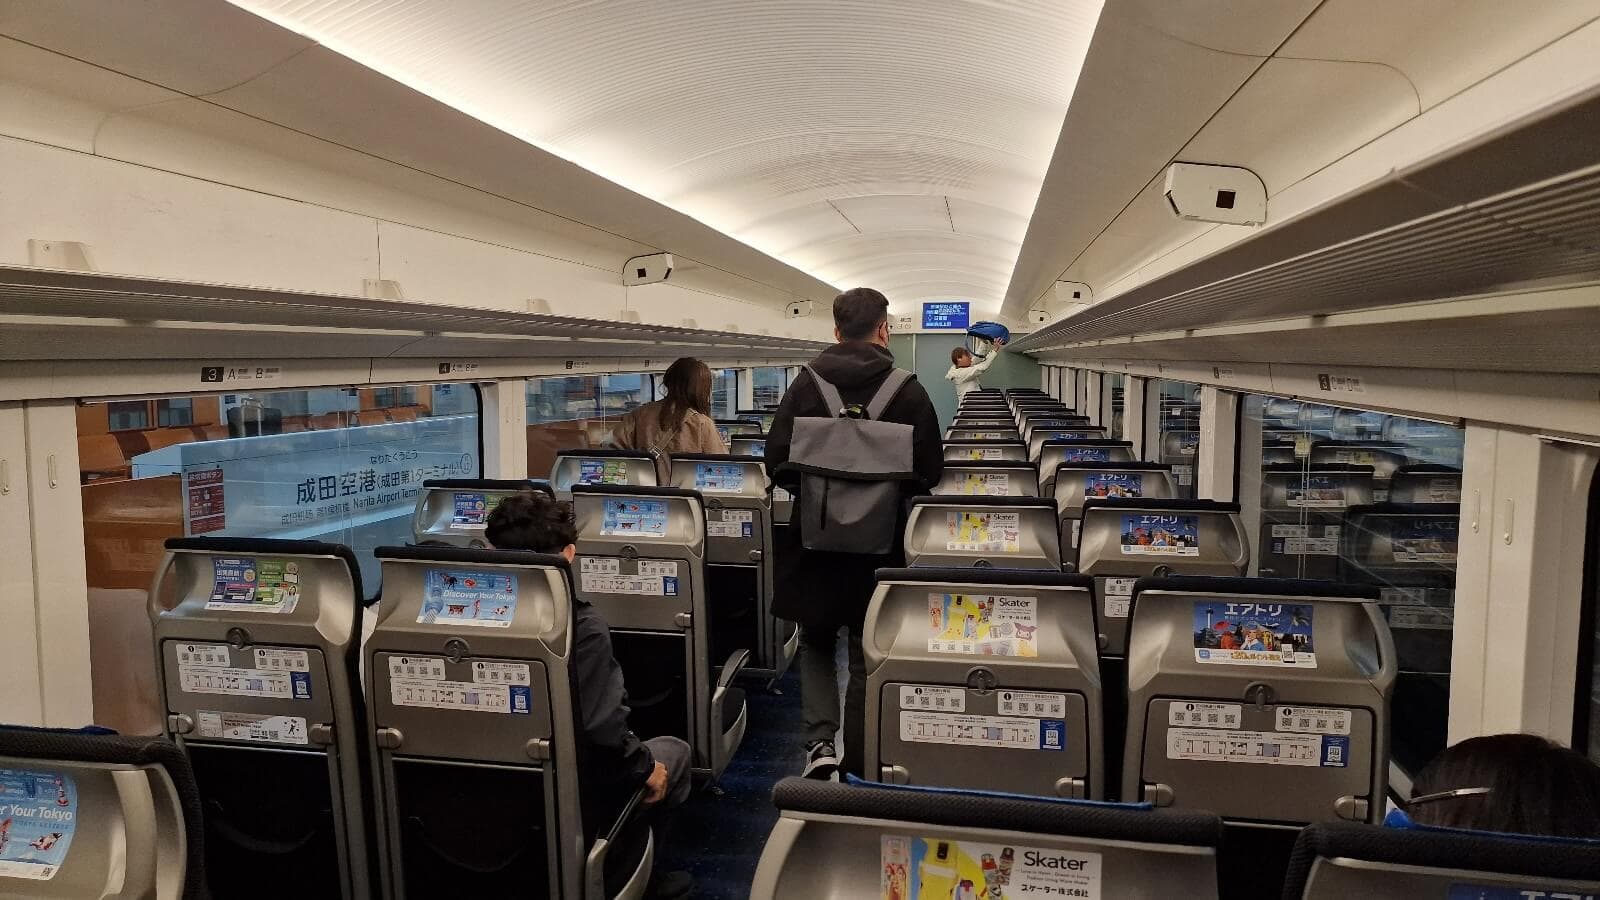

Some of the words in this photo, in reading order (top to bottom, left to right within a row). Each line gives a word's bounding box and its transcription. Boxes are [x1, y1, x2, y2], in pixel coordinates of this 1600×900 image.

[208, 368, 217, 381] 3
[227, 368, 236, 380] A
[256, 367, 263, 379] B
[370, 449, 418, 465] なりたくうこう
[1099, 473, 1128, 481] エアトリ
[353, 497, 375, 510] Narita
[377, 491, 401, 507] Airport
[1140, 514, 1178, 525] エアトリ
[442, 589, 478, 600] Discover
[479, 592, 495, 600] Your
[495, 592, 516, 602] Tokyo
[999, 597, 1031, 608] Skater
[1224, 602, 1282, 617] エアトリ
[9, 804, 37, 818] Your
[38, 806, 73, 822] Tokyo
[1024, 851, 1088, 871] Skater
[1021, 884, 1089, 898] スケーター株式会社
